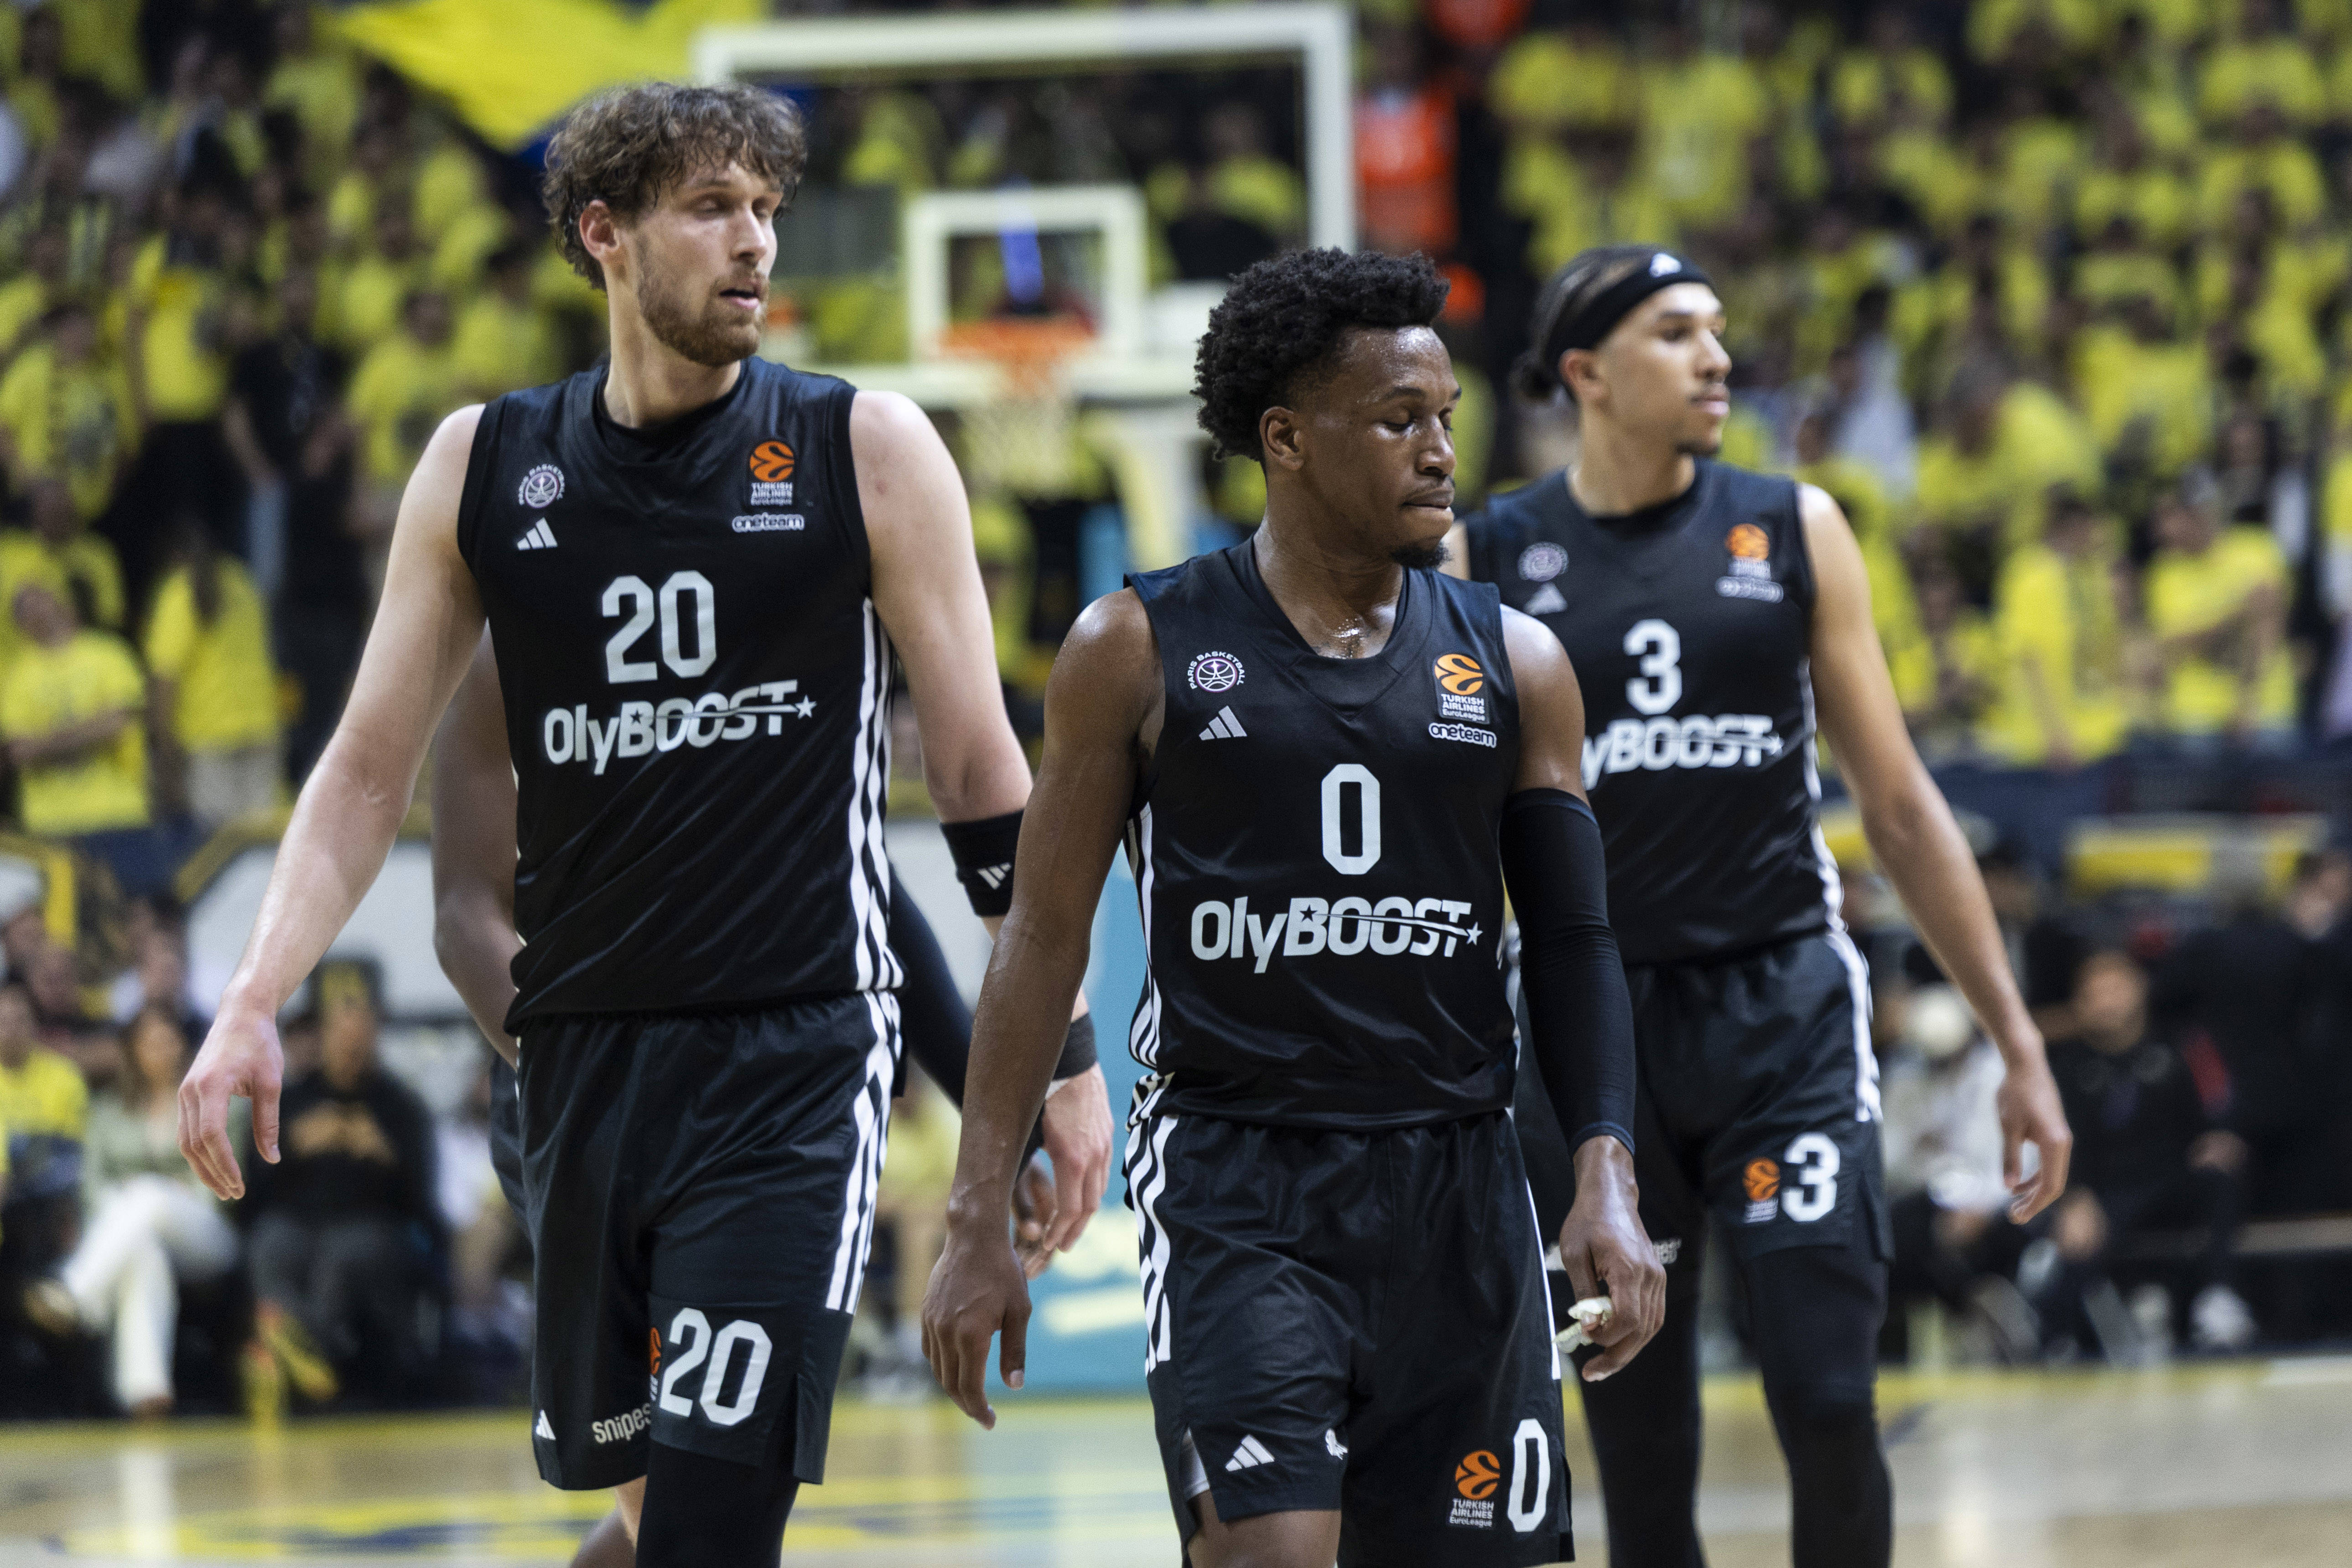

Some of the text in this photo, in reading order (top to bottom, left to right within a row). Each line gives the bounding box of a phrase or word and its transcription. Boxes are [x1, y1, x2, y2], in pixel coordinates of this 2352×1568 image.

[733, 514, 804, 532] oneteam
[602, 571, 717, 684] 20
[1187, 651, 1245, 689] PARIS BASKETBALL
[1623, 618, 1682, 715] 3
[1441, 693, 1485, 706] TURKISH
[1442, 701, 1485, 714] AIRLINES
[1442, 708, 1485, 721] EuroLeague
[544, 680, 798, 776] OlyBOOST
[1429, 724, 1496, 747] oneteam
[1321, 763, 1381, 875] 0
[1191, 896, 1472, 973] OlyBOOST
[1781, 1132, 1840, 1222] 3
[659, 1307, 773, 1426] 20
[1507, 1418, 1550, 1532] 0
[1449, 1516, 1492, 1528] EuroLeague
[1451, 1507, 1493, 1520] AIRLINES
[1452, 1498, 1494, 1511] TURKISH
